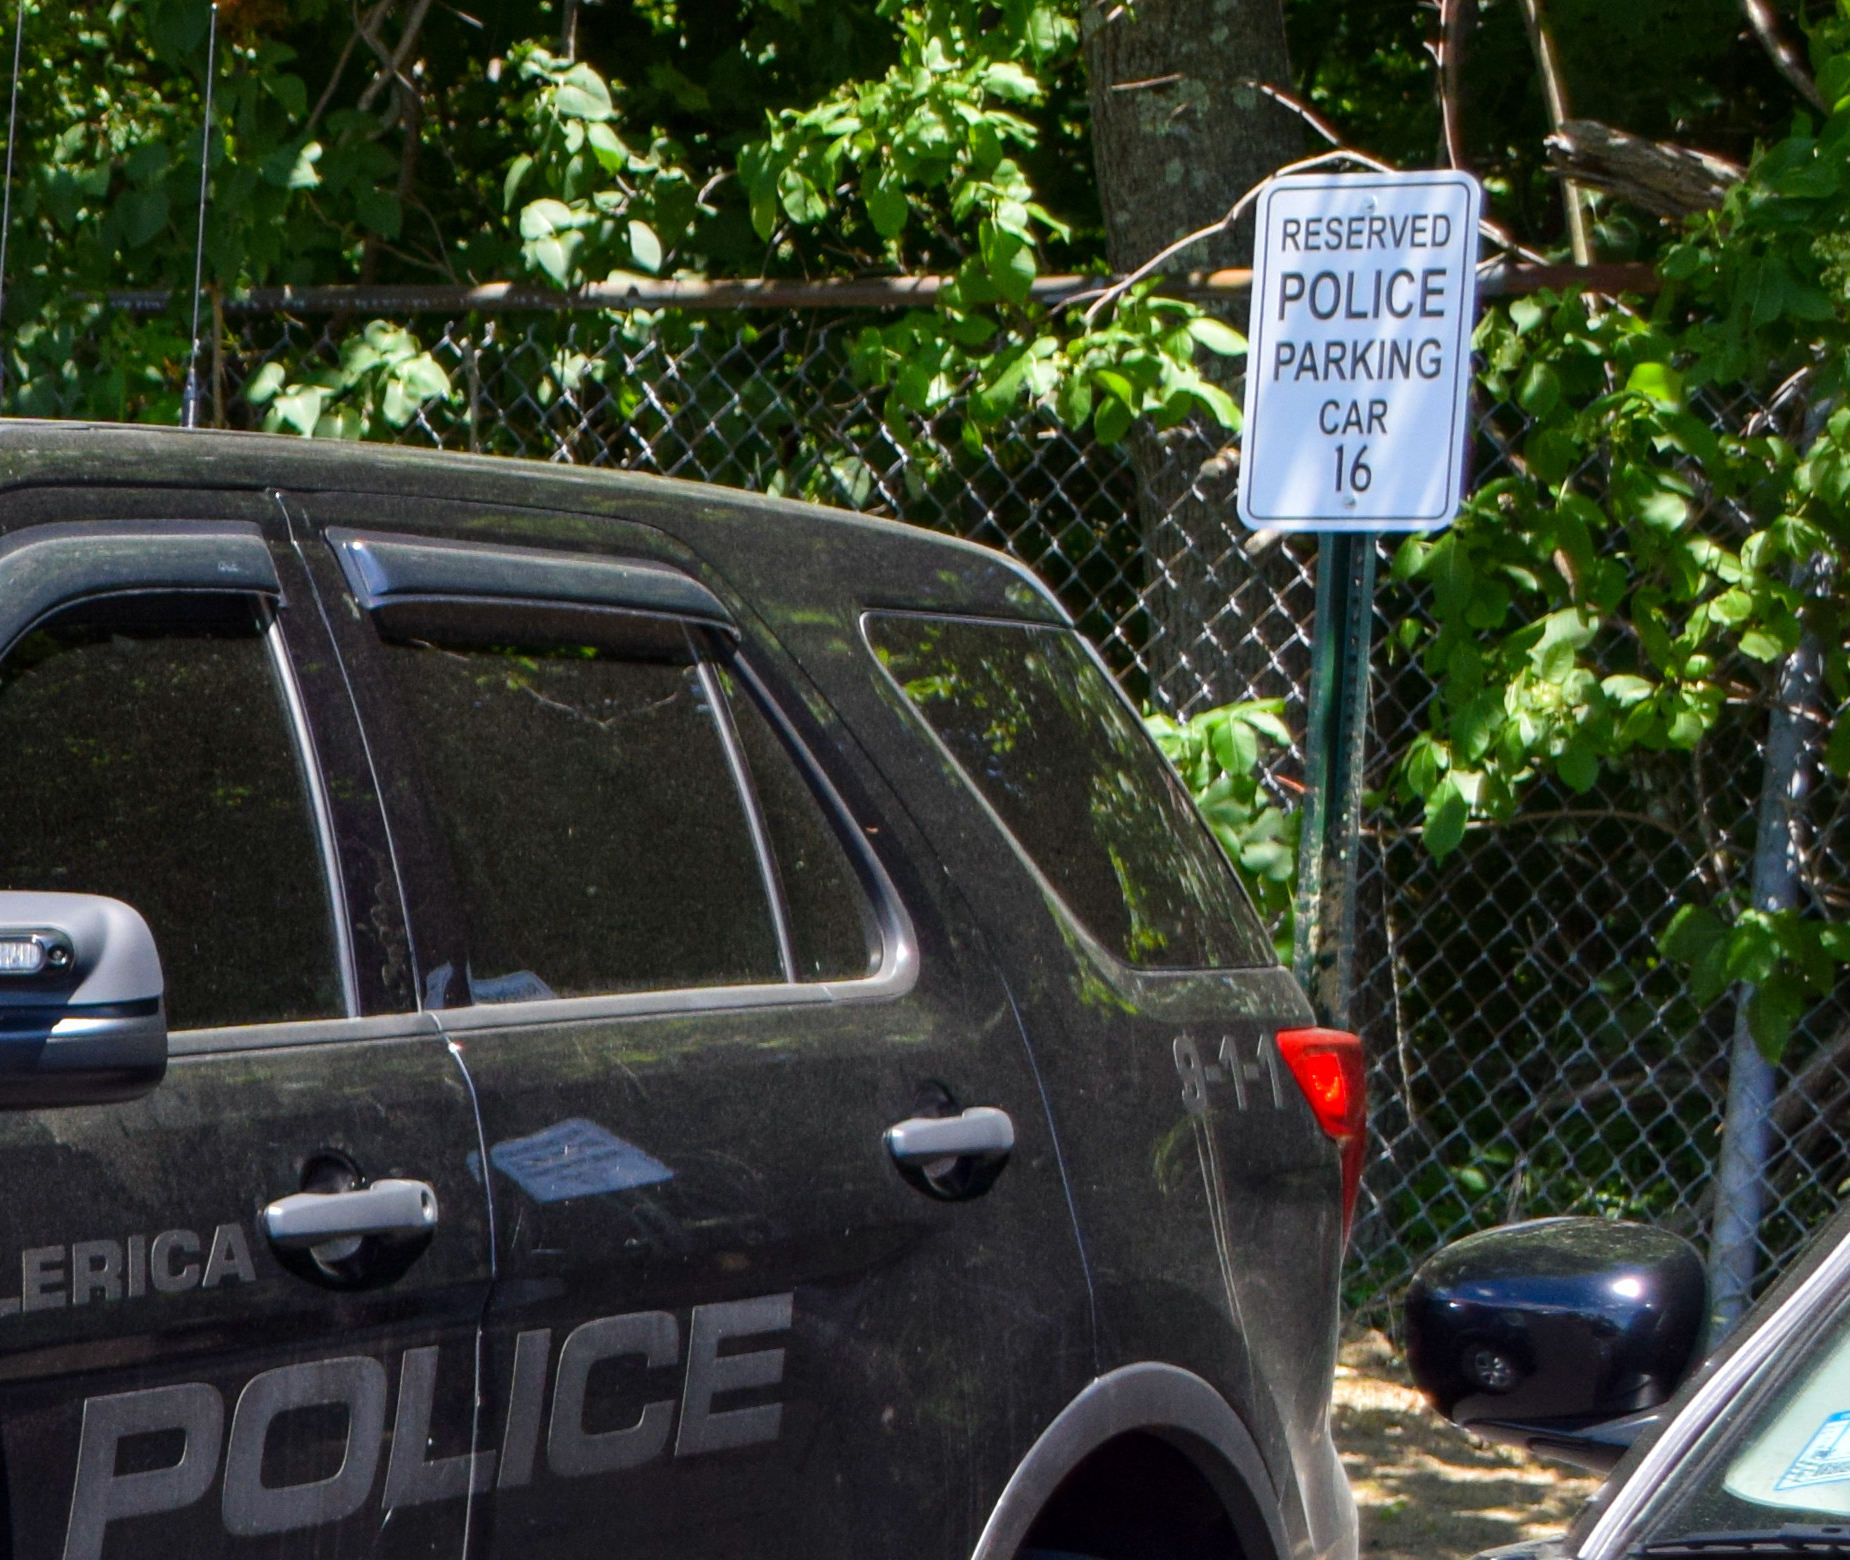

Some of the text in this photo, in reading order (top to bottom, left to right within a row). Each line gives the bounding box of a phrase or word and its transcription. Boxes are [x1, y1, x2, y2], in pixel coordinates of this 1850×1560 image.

[1280, 213, 1453, 252] RESERVED
[1277, 267, 1448, 321] POLICE
[1272, 337, 1443, 382] PARKING
[1318, 398, 1389, 436] CAR
[1334, 443, 1373, 493] 16
[1172, 1031, 1283, 1115] 9-1-1
